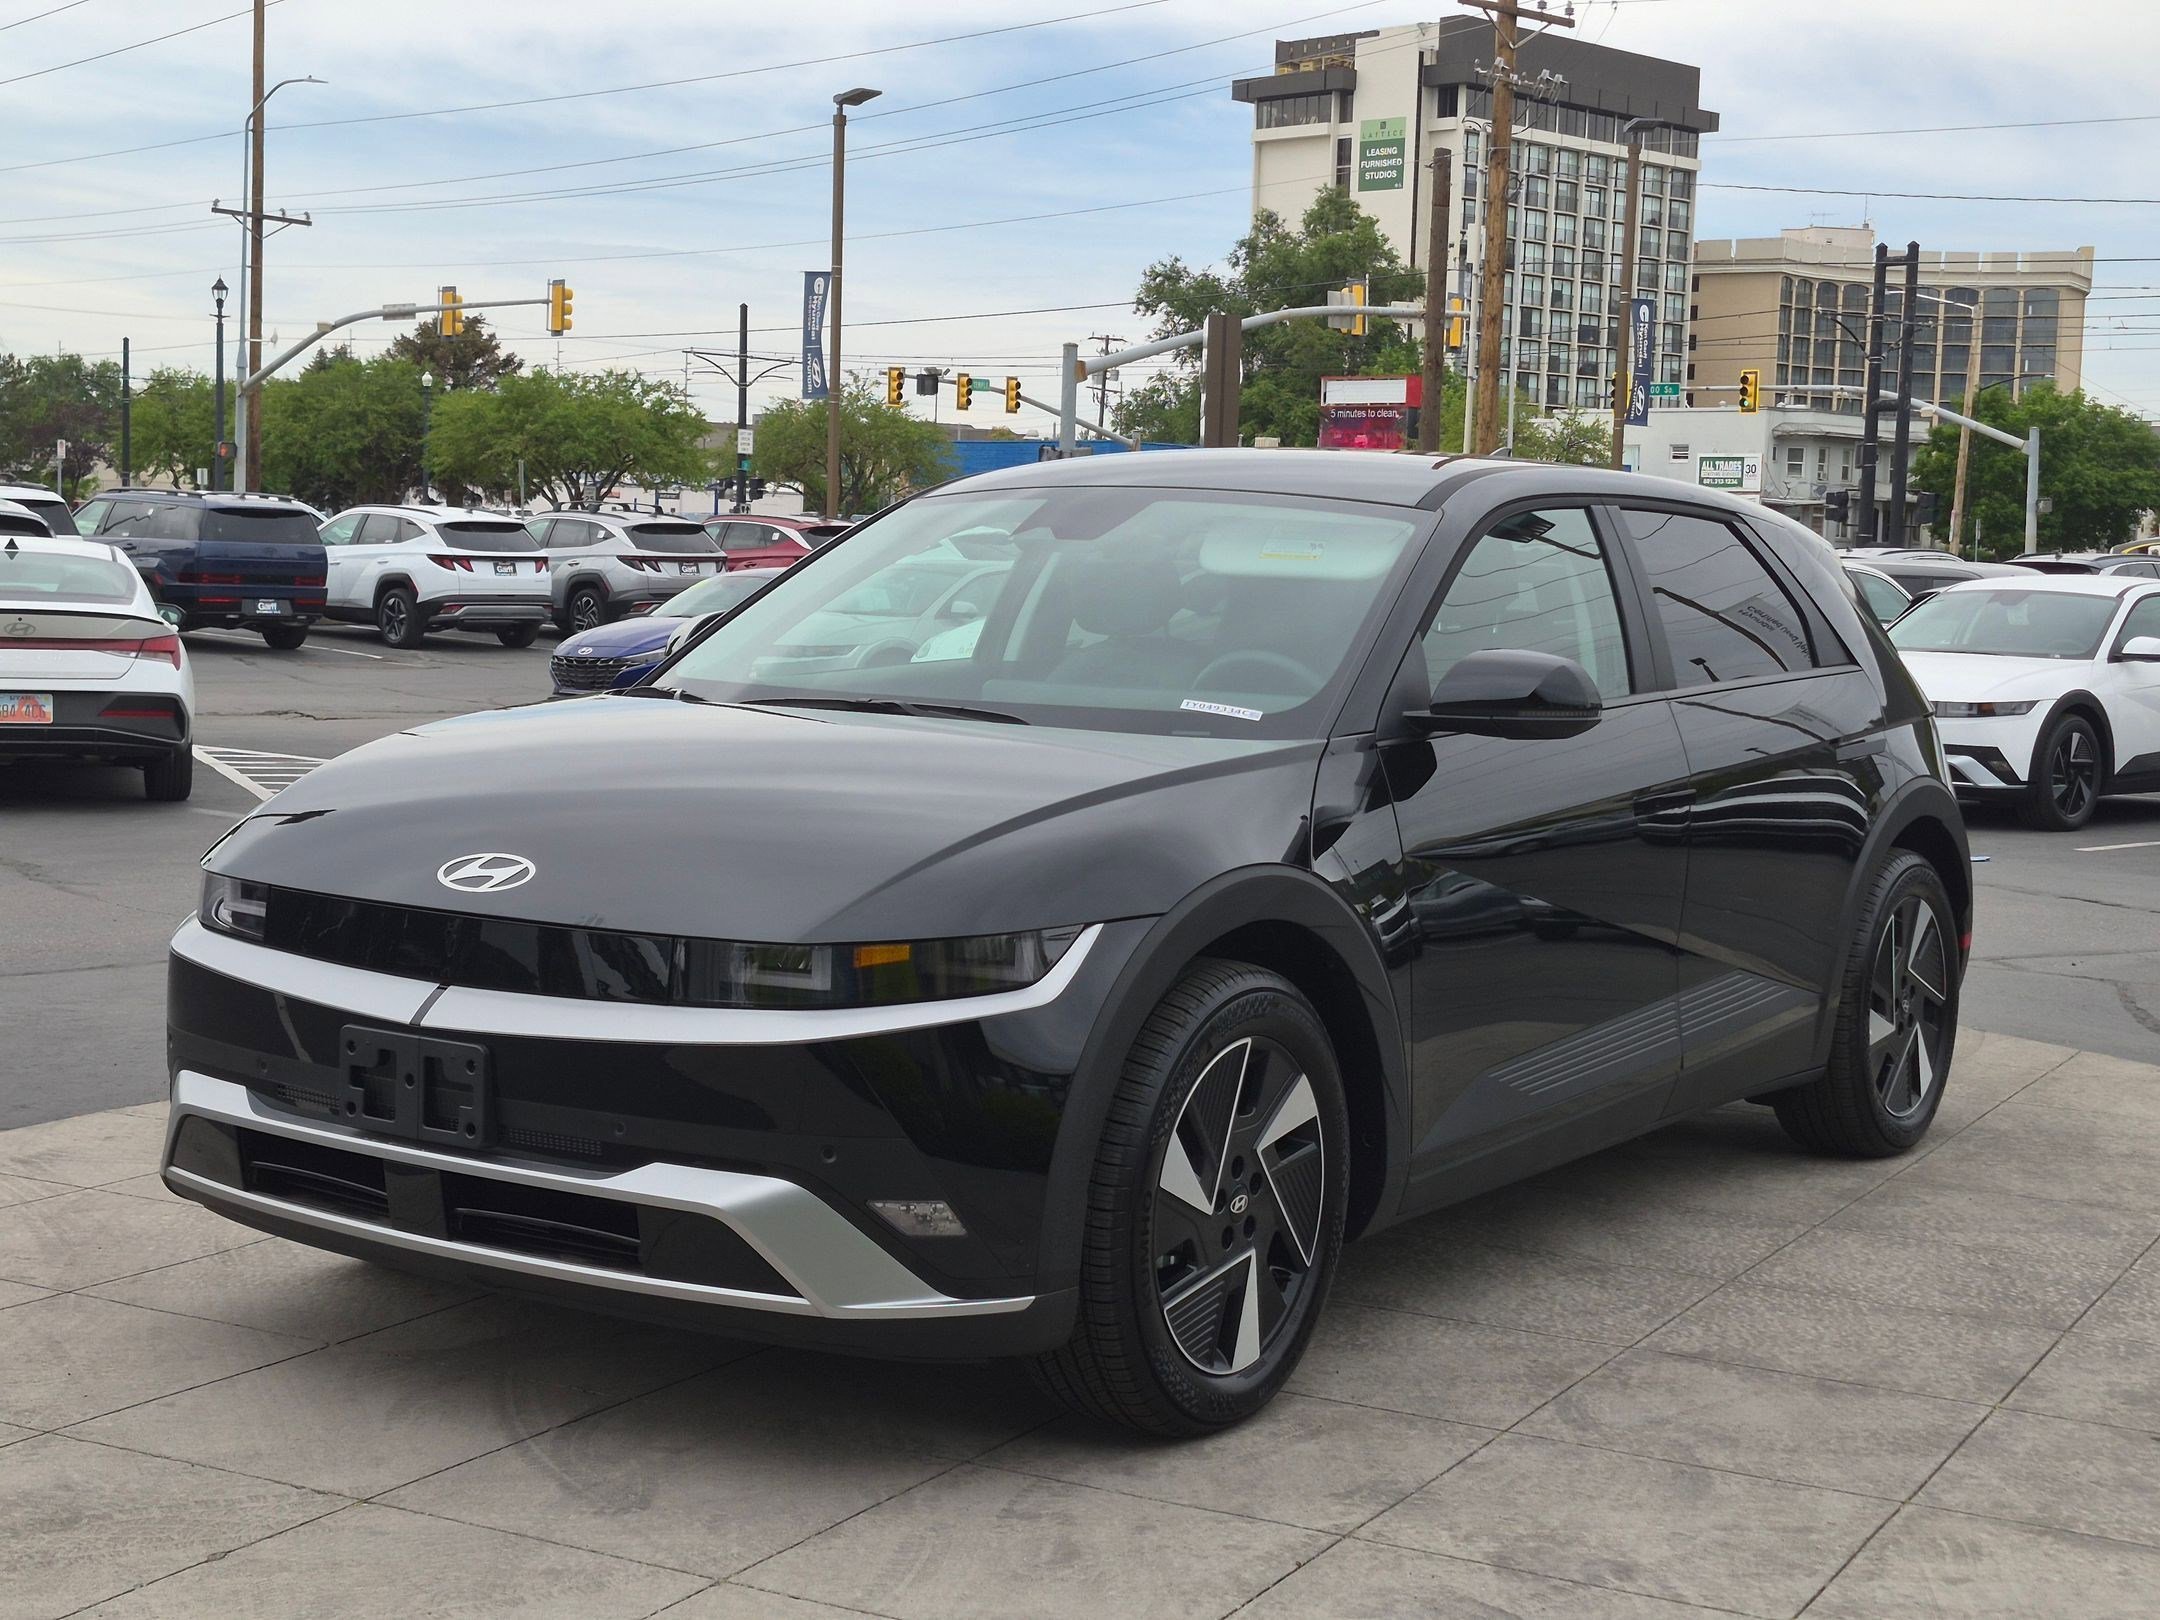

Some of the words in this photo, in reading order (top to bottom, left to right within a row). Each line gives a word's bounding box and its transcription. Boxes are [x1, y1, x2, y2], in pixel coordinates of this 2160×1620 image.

[1362, 130, 1404, 139] LATTICE
[1366, 146, 1398, 157] LEASING
[1360, 158, 1403, 169] FURNISHED
[1365, 170, 1397, 180] STUDIOS
[810, 295, 818, 340] Hyundai
[1330, 409, 1336, 418] 5
[1337, 408, 1367, 418] minutes
[1368, 408, 1376, 418] to
[1701, 460, 1714, 471] ALL
[1715, 460, 1742, 471] TRADES
[1745, 464, 1757, 474] 30
